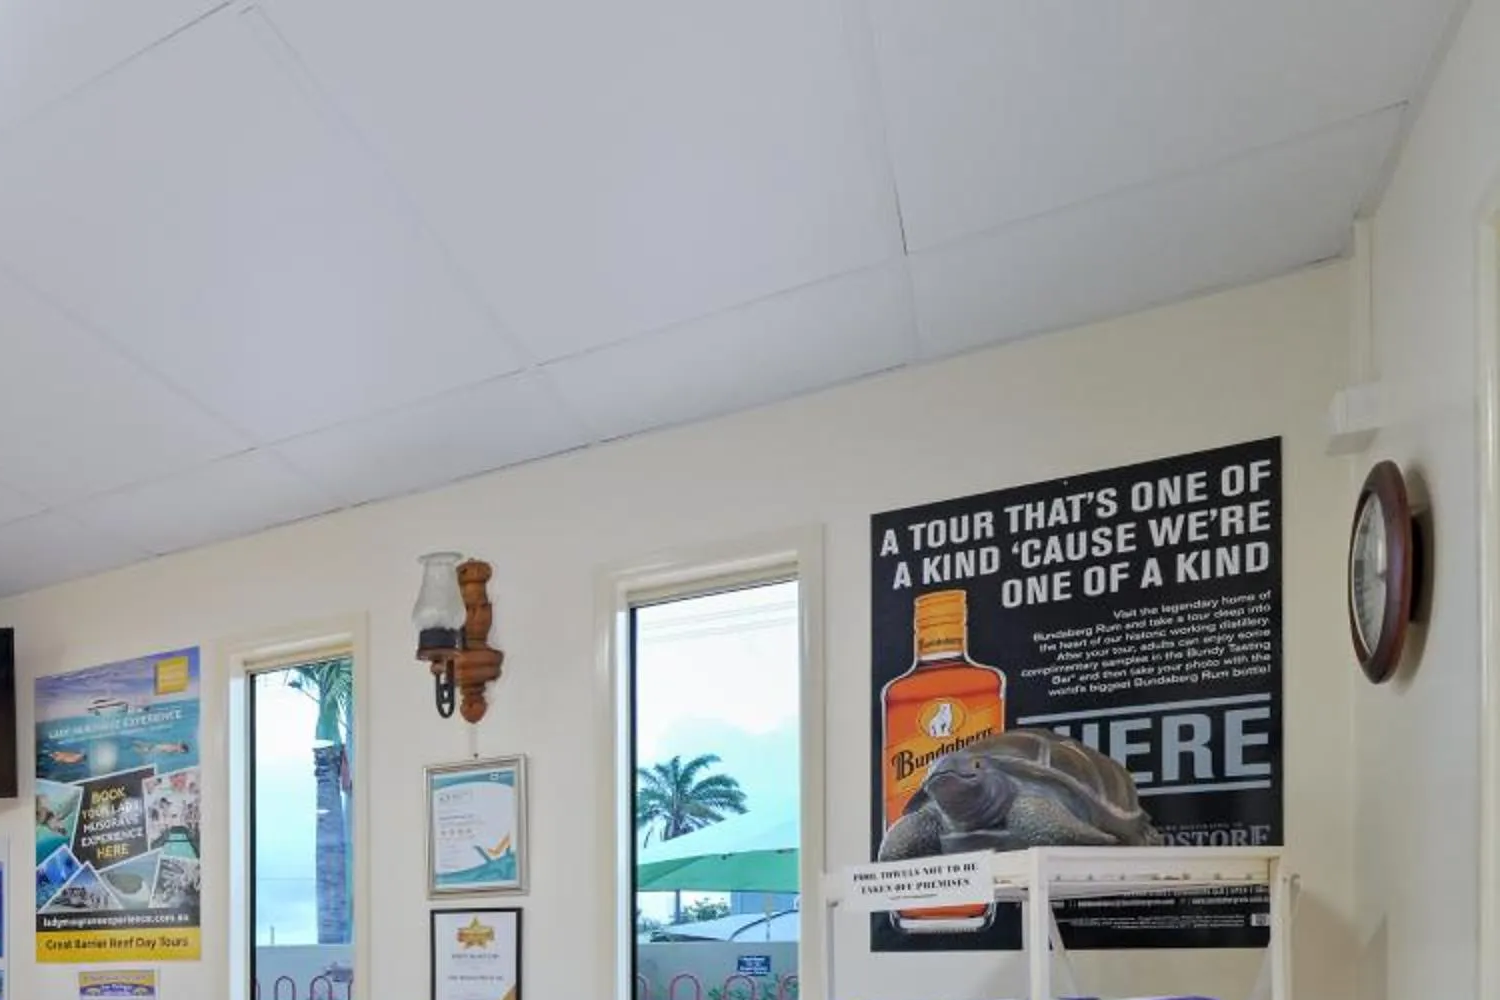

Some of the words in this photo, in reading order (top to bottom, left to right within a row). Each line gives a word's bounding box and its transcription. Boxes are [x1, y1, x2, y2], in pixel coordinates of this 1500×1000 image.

[880, 528, 899, 557] A
[908, 511, 995, 551] TOUR
[1004, 487, 1117, 535] THAT'S
[1131, 471, 1208, 513] ONE
[1220, 459, 1272, 497] OF
[892, 561, 912, 590] A
[922, 546, 1000, 585] KIND
[1011, 522, 1137, 570] 'CAUSE
[1148, 500, 1271, 548] WE'RE
[1001, 570, 1072, 609] ONE
[1083, 562, 1130, 597] OF
[1140, 557, 1163, 589] A
[1176, 540, 1270, 584] KIND
[1113, 609, 1137, 619] Visit
[1162, 599, 1219, 613] legendary
[1222, 594, 1255, 605] home
[1259, 589, 1272, 601] of
[1096, 624, 1122, 633] Rum
[1125, 620, 1146, 629] and
[1149, 617, 1173, 626] take
[1187, 613, 1210, 621] tour
[1213, 608, 1244, 618] deep
[1169, 624, 1216, 635] working
[1202, 670, 1229, 680] Rum
[1053, 706, 1271, 784] ERE
[97, 843, 130, 859] HERE
[110, 936, 134, 949] Reef
[135, 938, 156, 950] Day
